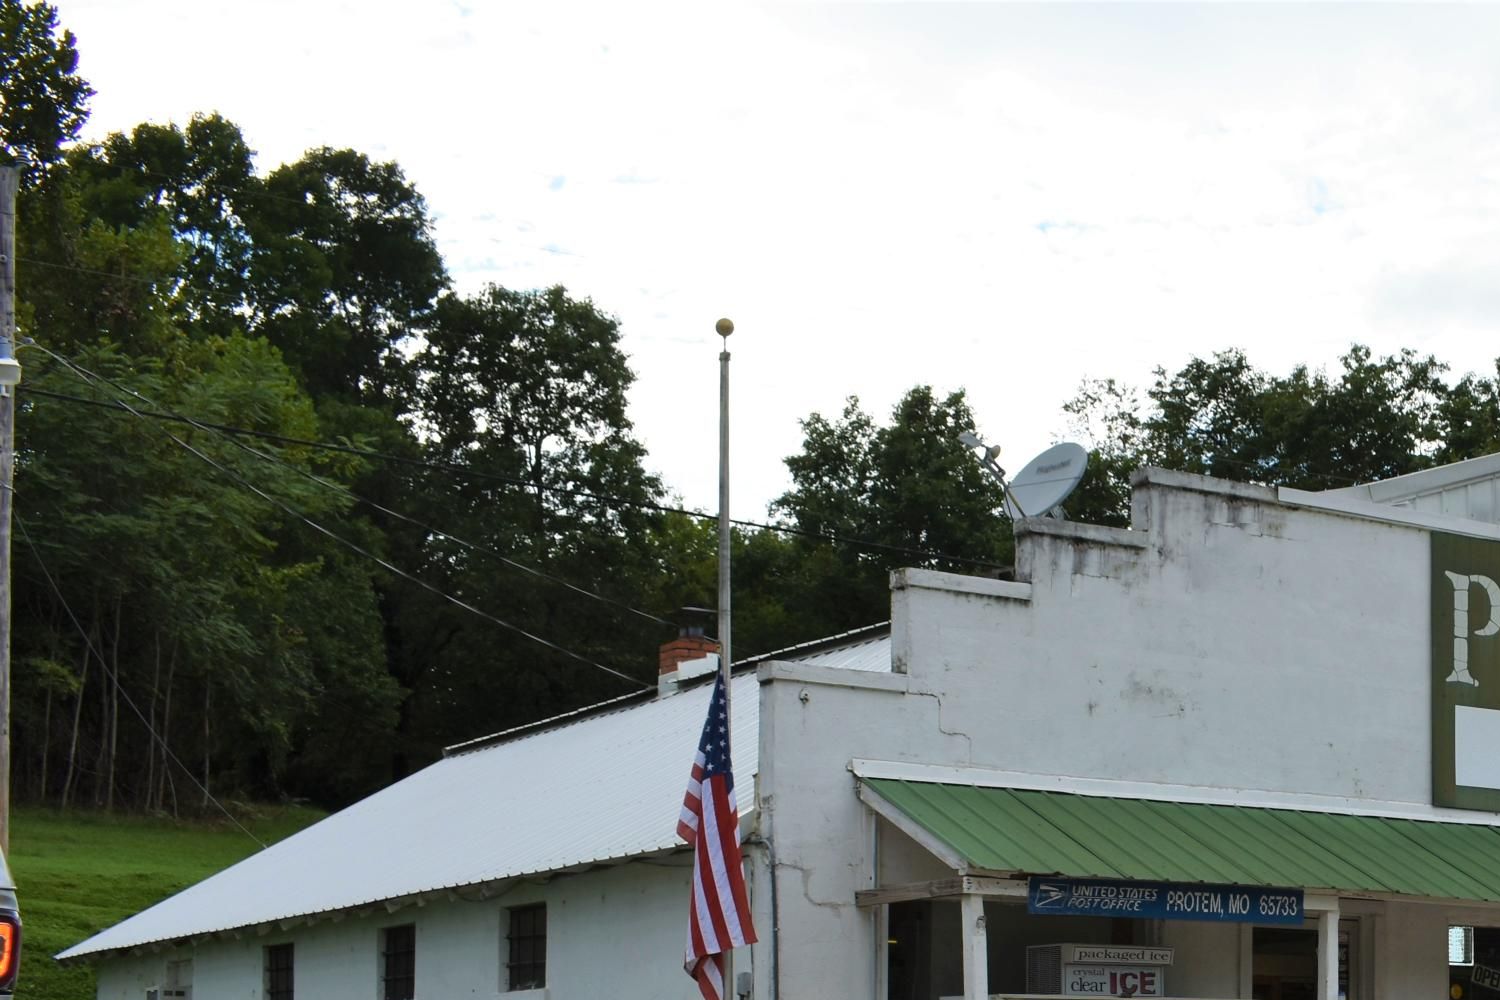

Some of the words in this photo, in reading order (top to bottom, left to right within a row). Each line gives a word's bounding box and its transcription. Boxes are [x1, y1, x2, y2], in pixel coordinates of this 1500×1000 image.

[1072, 884, 1117, 897] UNITED
[1118, 887, 1158, 899] STATES
[1067, 898, 1099, 909] POST
[1100, 899, 1142, 911] OFFICE
[1166, 891, 1224, 917] PROTEM,
[1229, 894, 1250, 914] MO
[1260, 895, 1297, 916] 65733
[1078, 949, 1145, 961] packaged
[1150, 951, 1169, 961] ice
[1072, 967, 1105, 977] crystal
[1071, 978, 1107, 992] clear
[1109, 971, 1156, 995] ICE
